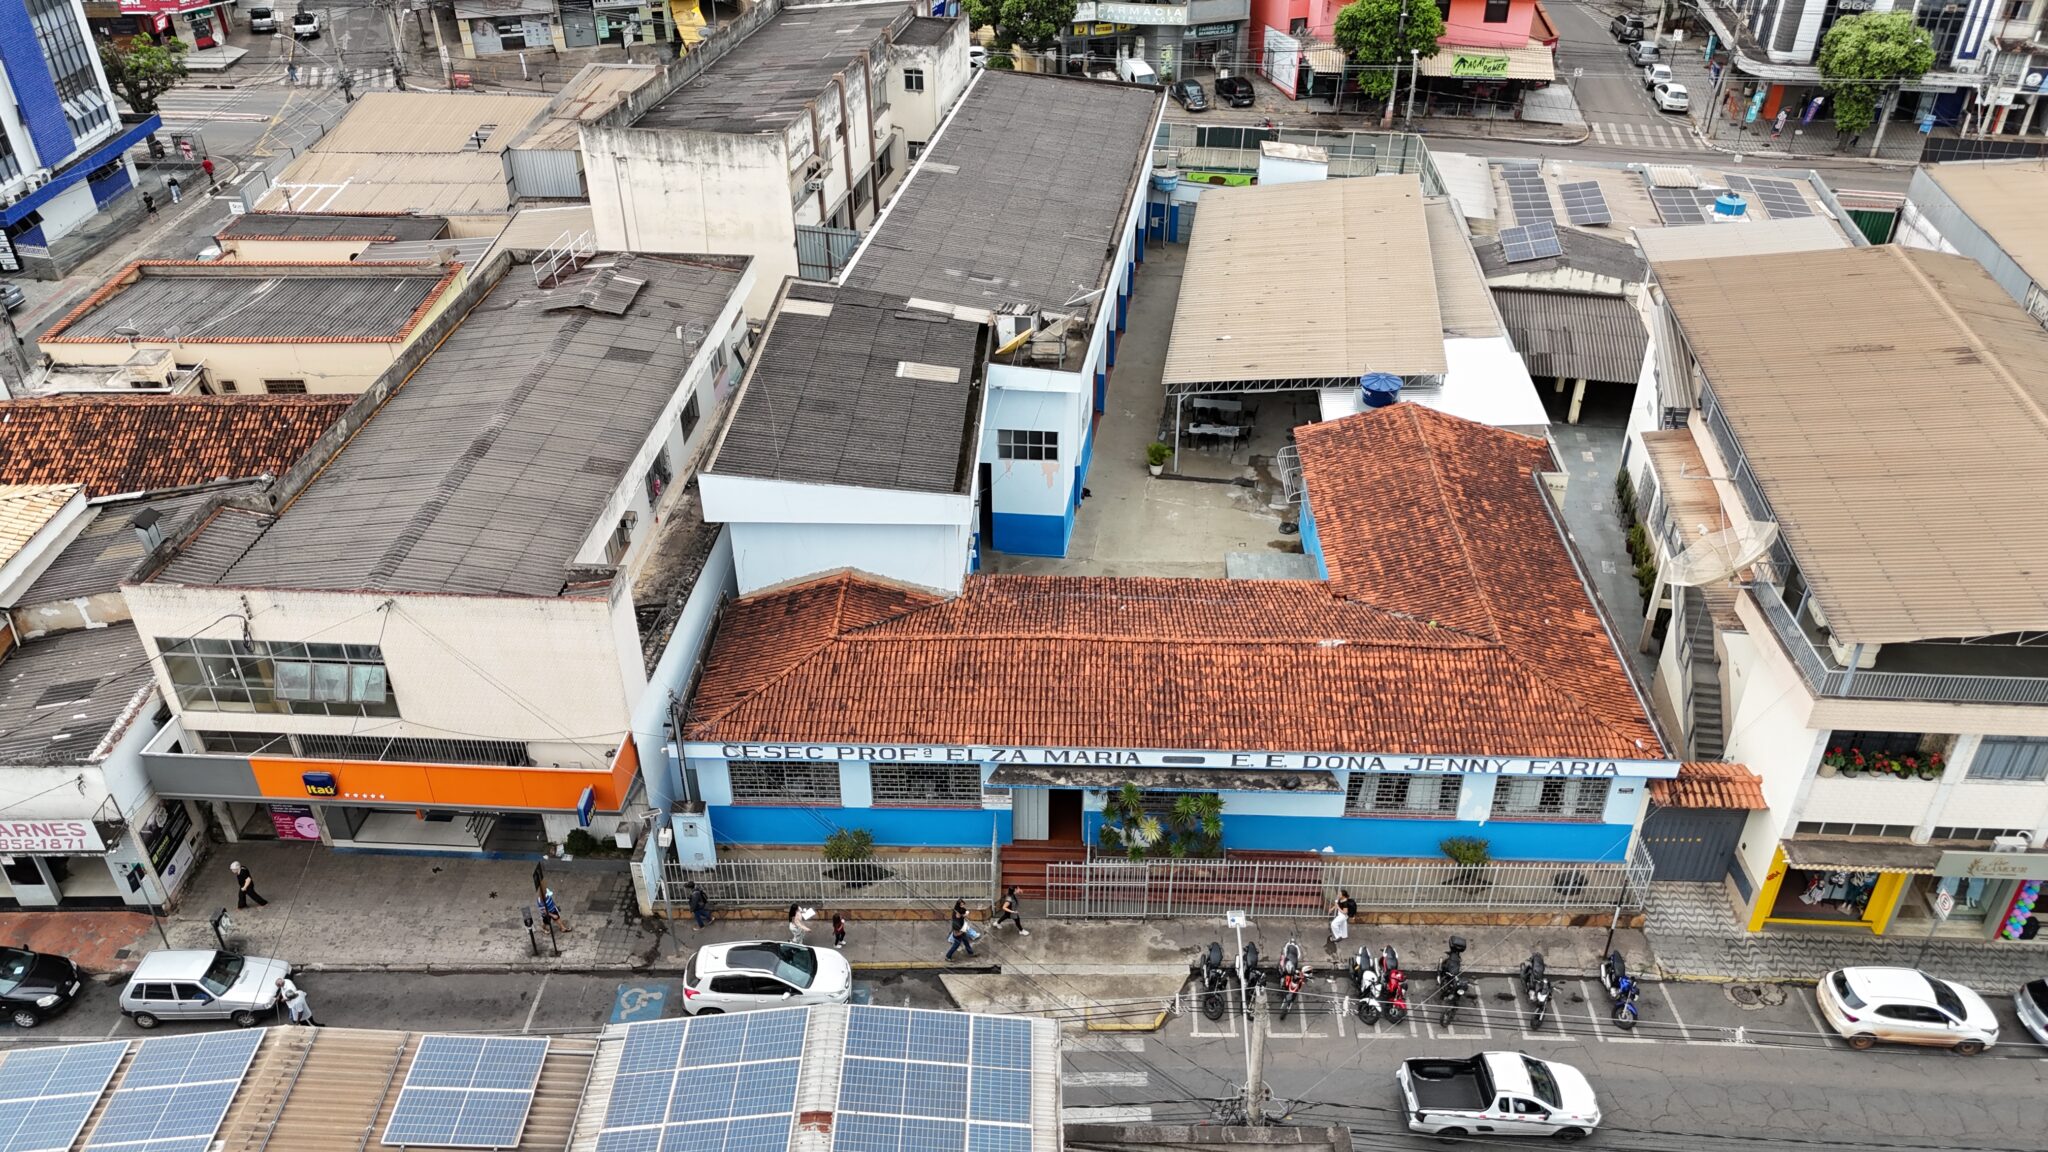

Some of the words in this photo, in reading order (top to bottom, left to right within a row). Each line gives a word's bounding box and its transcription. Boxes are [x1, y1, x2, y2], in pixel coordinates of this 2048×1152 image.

[722, 745, 823, 759] CESEC
[946, 748, 1027, 762] ELZA
[1043, 750, 1142, 765] MARIA
[1230, 754, 1254, 767] E.
[1265, 754, 1288, 768] E.
[1302, 755, 1386, 770] DONA
[1403, 757, 1510, 774] JENNY
[1527, 760, 1619, 776] FARIA
[306, 785, 335, 795] Itaú
